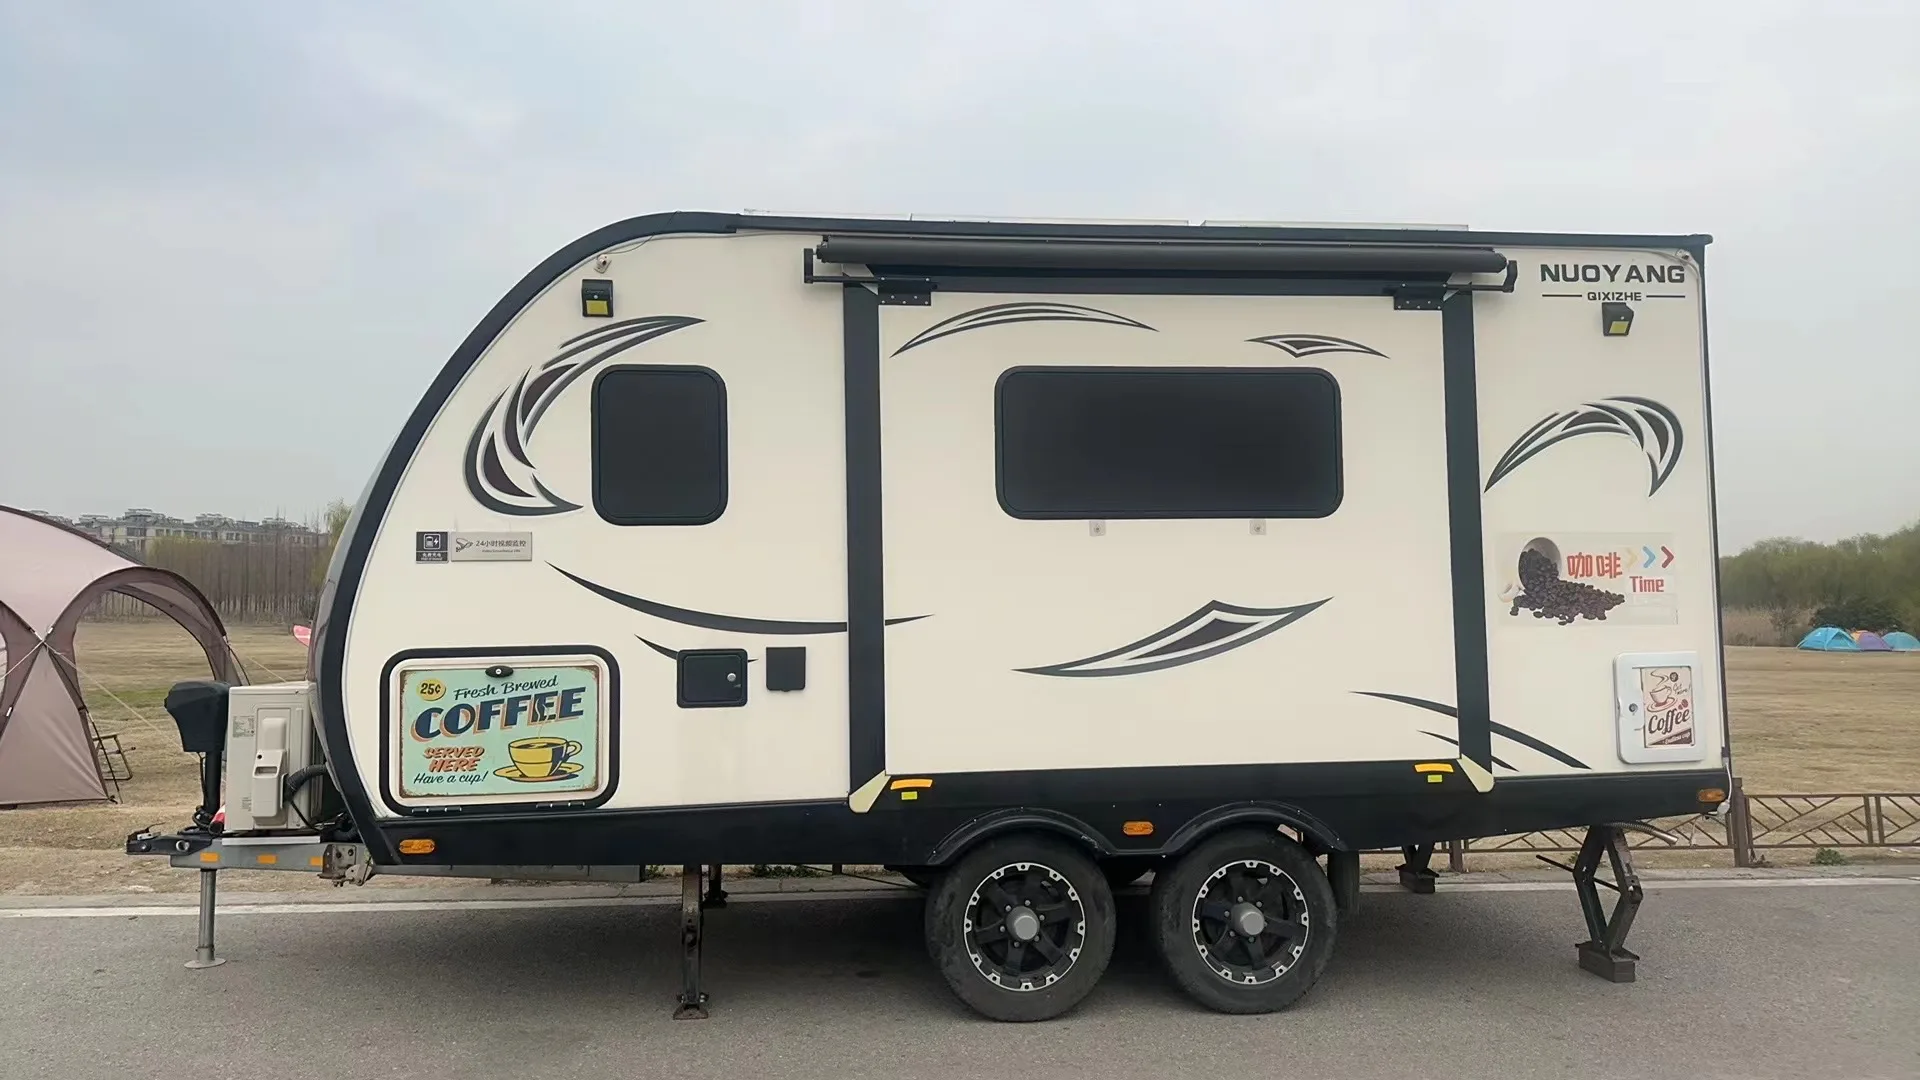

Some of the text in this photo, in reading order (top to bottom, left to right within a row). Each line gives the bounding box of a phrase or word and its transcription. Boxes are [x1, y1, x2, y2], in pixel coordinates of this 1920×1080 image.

[1540, 263, 1685, 283] NUOYANG
[1587, 291, 1642, 301] QIXIZHE
[1567, 551, 1623, 579] 咖啡
[1629, 575, 1665, 593] Time
[453, 674, 558, 701] Fresh Brewed
[411, 686, 587, 742] COFFEE
[1648, 708, 1690, 735] Coffee
[422, 745, 485, 759] SERVED
[428, 757, 481, 773] HERE
[413, 770, 489, 786] Have a cup!
